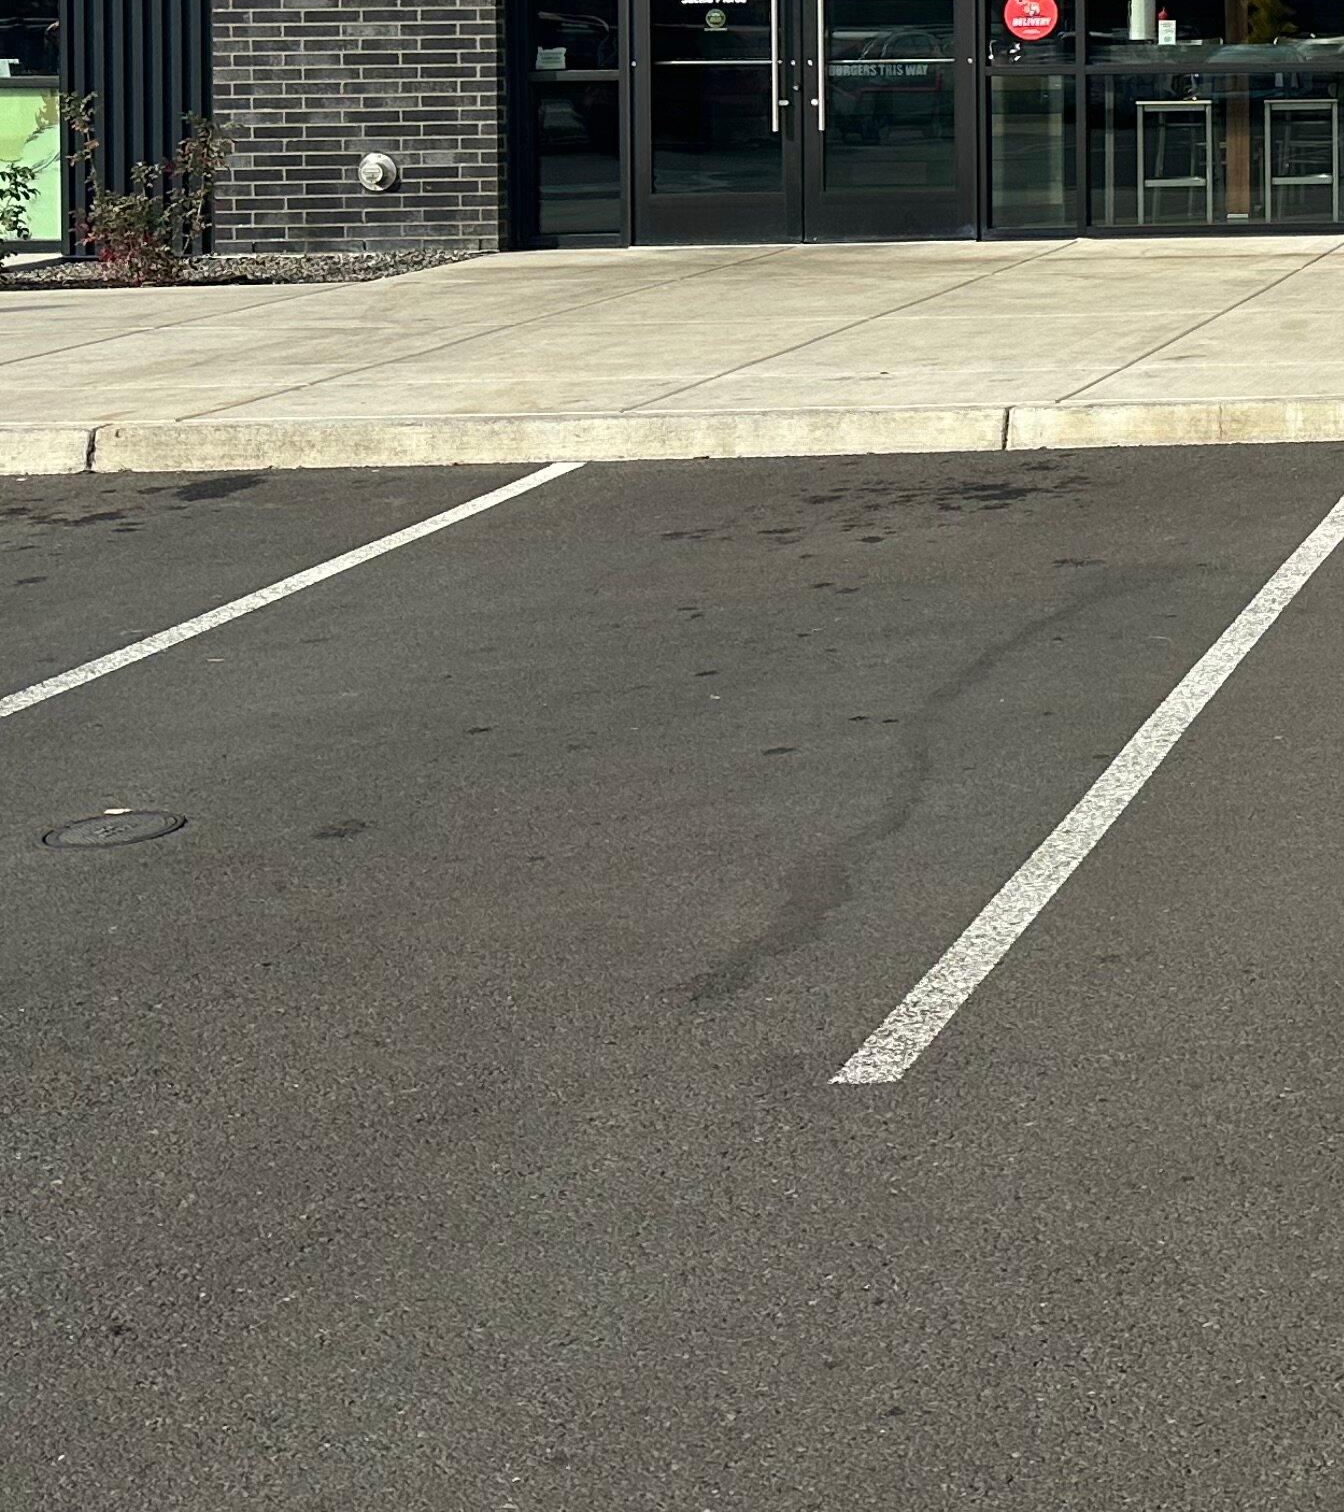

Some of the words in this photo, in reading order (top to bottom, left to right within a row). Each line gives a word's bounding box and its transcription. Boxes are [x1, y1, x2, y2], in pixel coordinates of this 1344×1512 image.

[1011, 16, 1052, 27] DELIVERY
[878, 64, 904, 76] THIS
[905, 64, 928, 76] WAY
